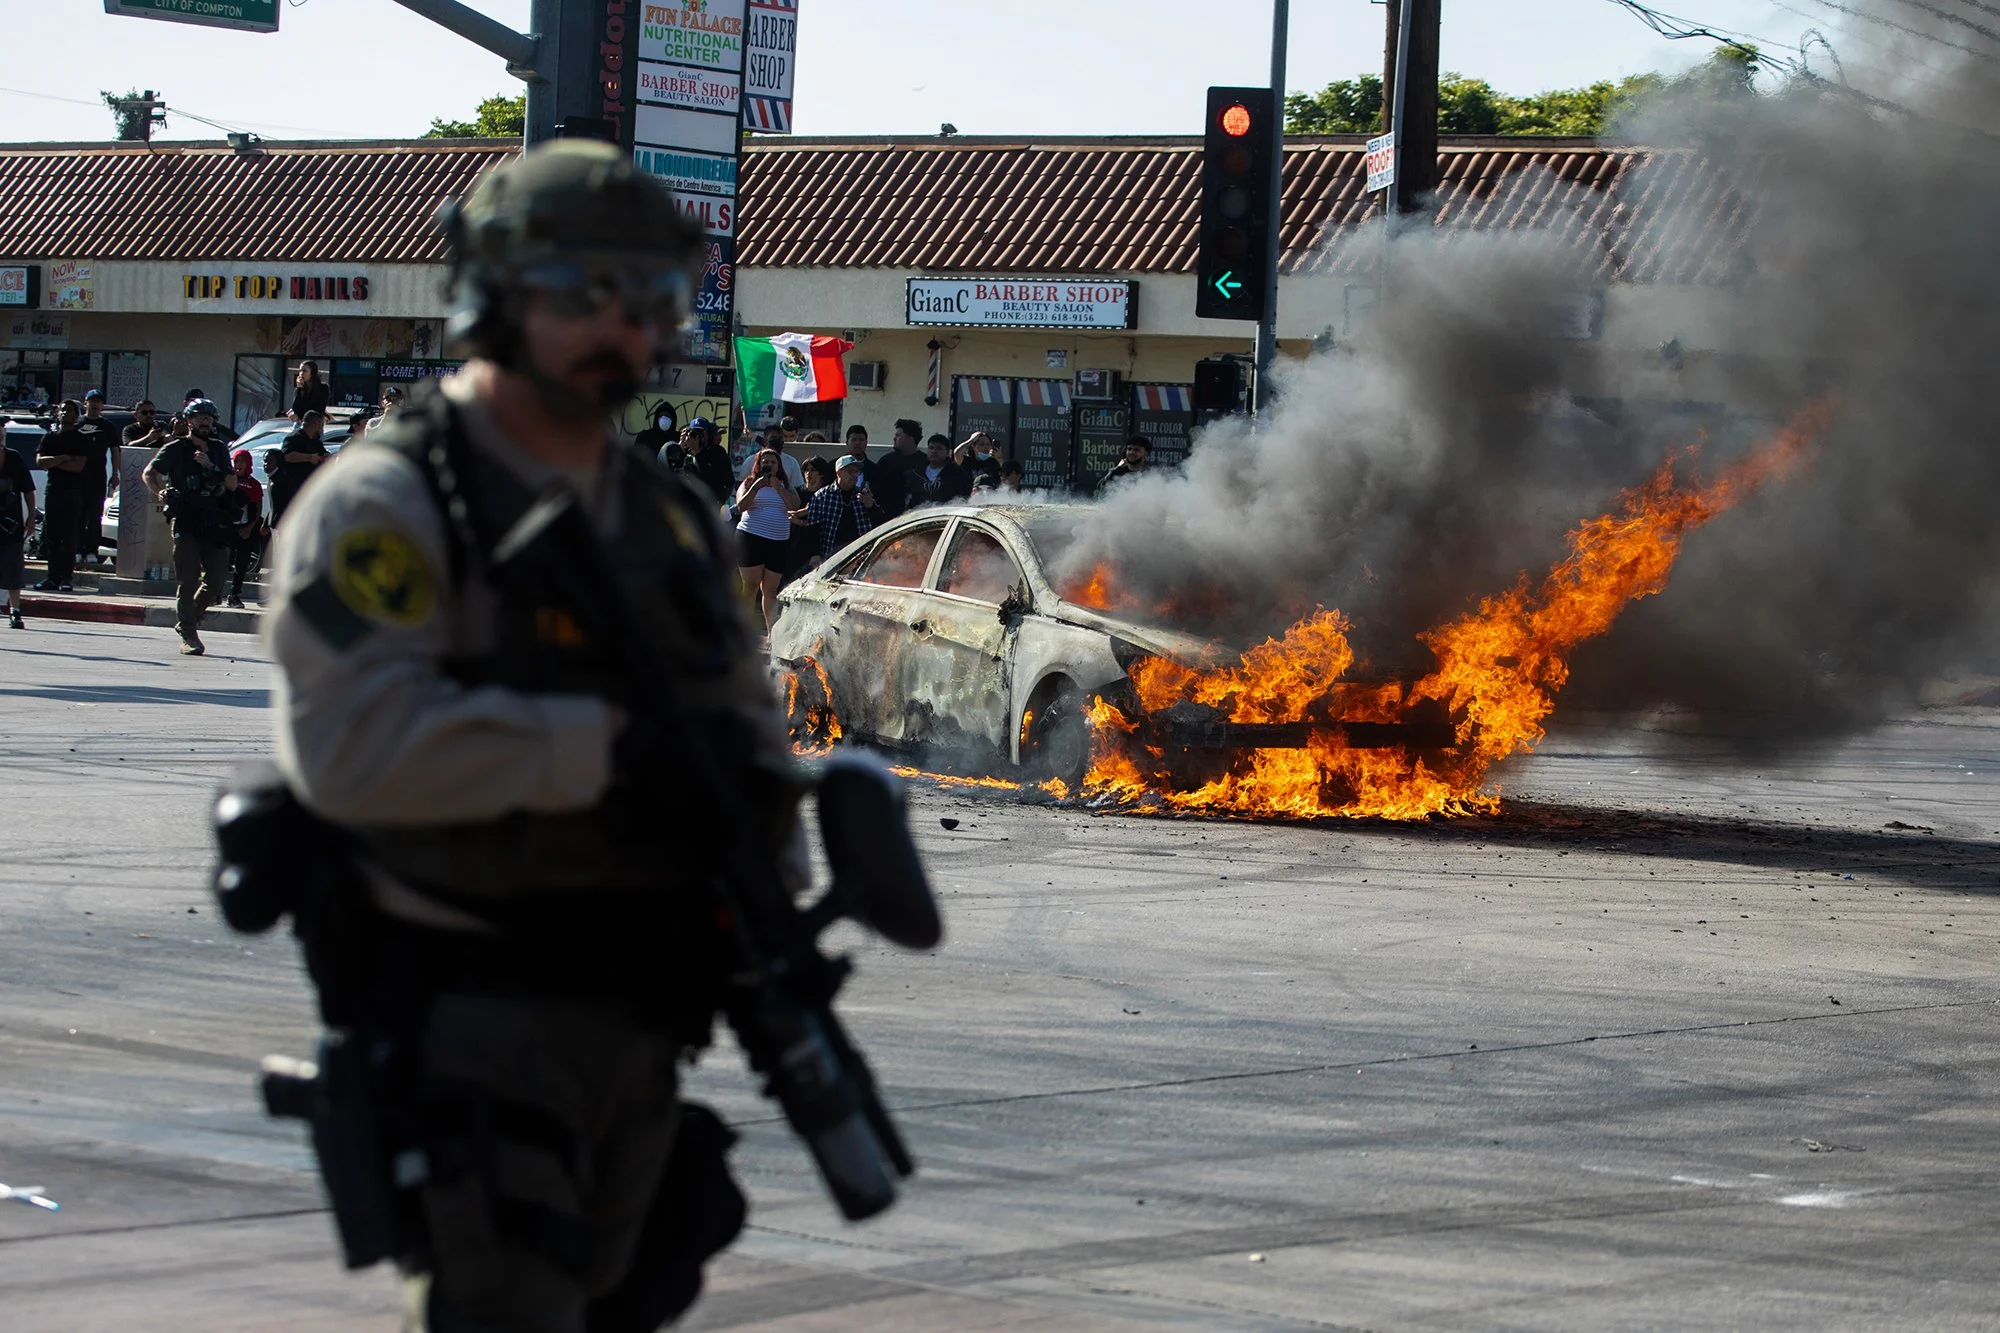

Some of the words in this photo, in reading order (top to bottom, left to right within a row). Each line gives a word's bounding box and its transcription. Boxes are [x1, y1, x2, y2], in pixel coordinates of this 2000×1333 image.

[155, 0, 177, 8] CITY
[180, 0, 193, 10] OF
[196, 3, 243, 17] COMPTON
[644, 5, 678, 27] FUN
[680, 10, 742, 36] PALACE
[644, 26, 740, 51] NUTRITIONAL
[664, 43, 720, 64] CENTER
[678, 70, 704, 82] GianC
[749, 53, 786, 90] SHOP
[641, 73, 698, 94] BARBER
[702, 85, 739, 100] SHOP
[654, 90, 692, 103] BEAUTY
[694, 94, 725, 106] SALON
[676, 178, 682, 188] de
[684, 180, 700, 190] Centro
[701, 182, 721, 192] America
[52, 260, 76, 279] NOW
[182, 276, 226, 298] TIP
[233, 276, 282, 299] TOP
[290, 276, 369, 300] NAILS
[975, 284, 1060, 302] BARBER
[1066, 286, 1124, 304] SHOP
[911, 288, 970, 314] GianC
[1003, 302, 1051, 312] BEAUTY
[1054, 302, 1094, 312] SALON
[694, 311, 726, 322] NATURAL
[1052, 314, 1094, 322] 618-9156
[968, 418, 996, 426] PHONE
[1018, 417, 1050, 430] REGULAR
[1050, 419, 1068, 430] CUTS
[1080, 408, 1124, 427] GianC
[1140, 422, 1158, 433] HAIR
[1159, 422, 1183, 434] COLOR
[1032, 432, 1052, 444] FADES
[1030, 446, 1052, 458] TAPER
[1082, 439, 1122, 455] Barber
[1024, 460, 1042, 472] FLAT
[1043, 460, 1056, 472] TOP
[1086, 456, 1115, 472] Shop
[1040, 474, 1065, 486] STYLES
